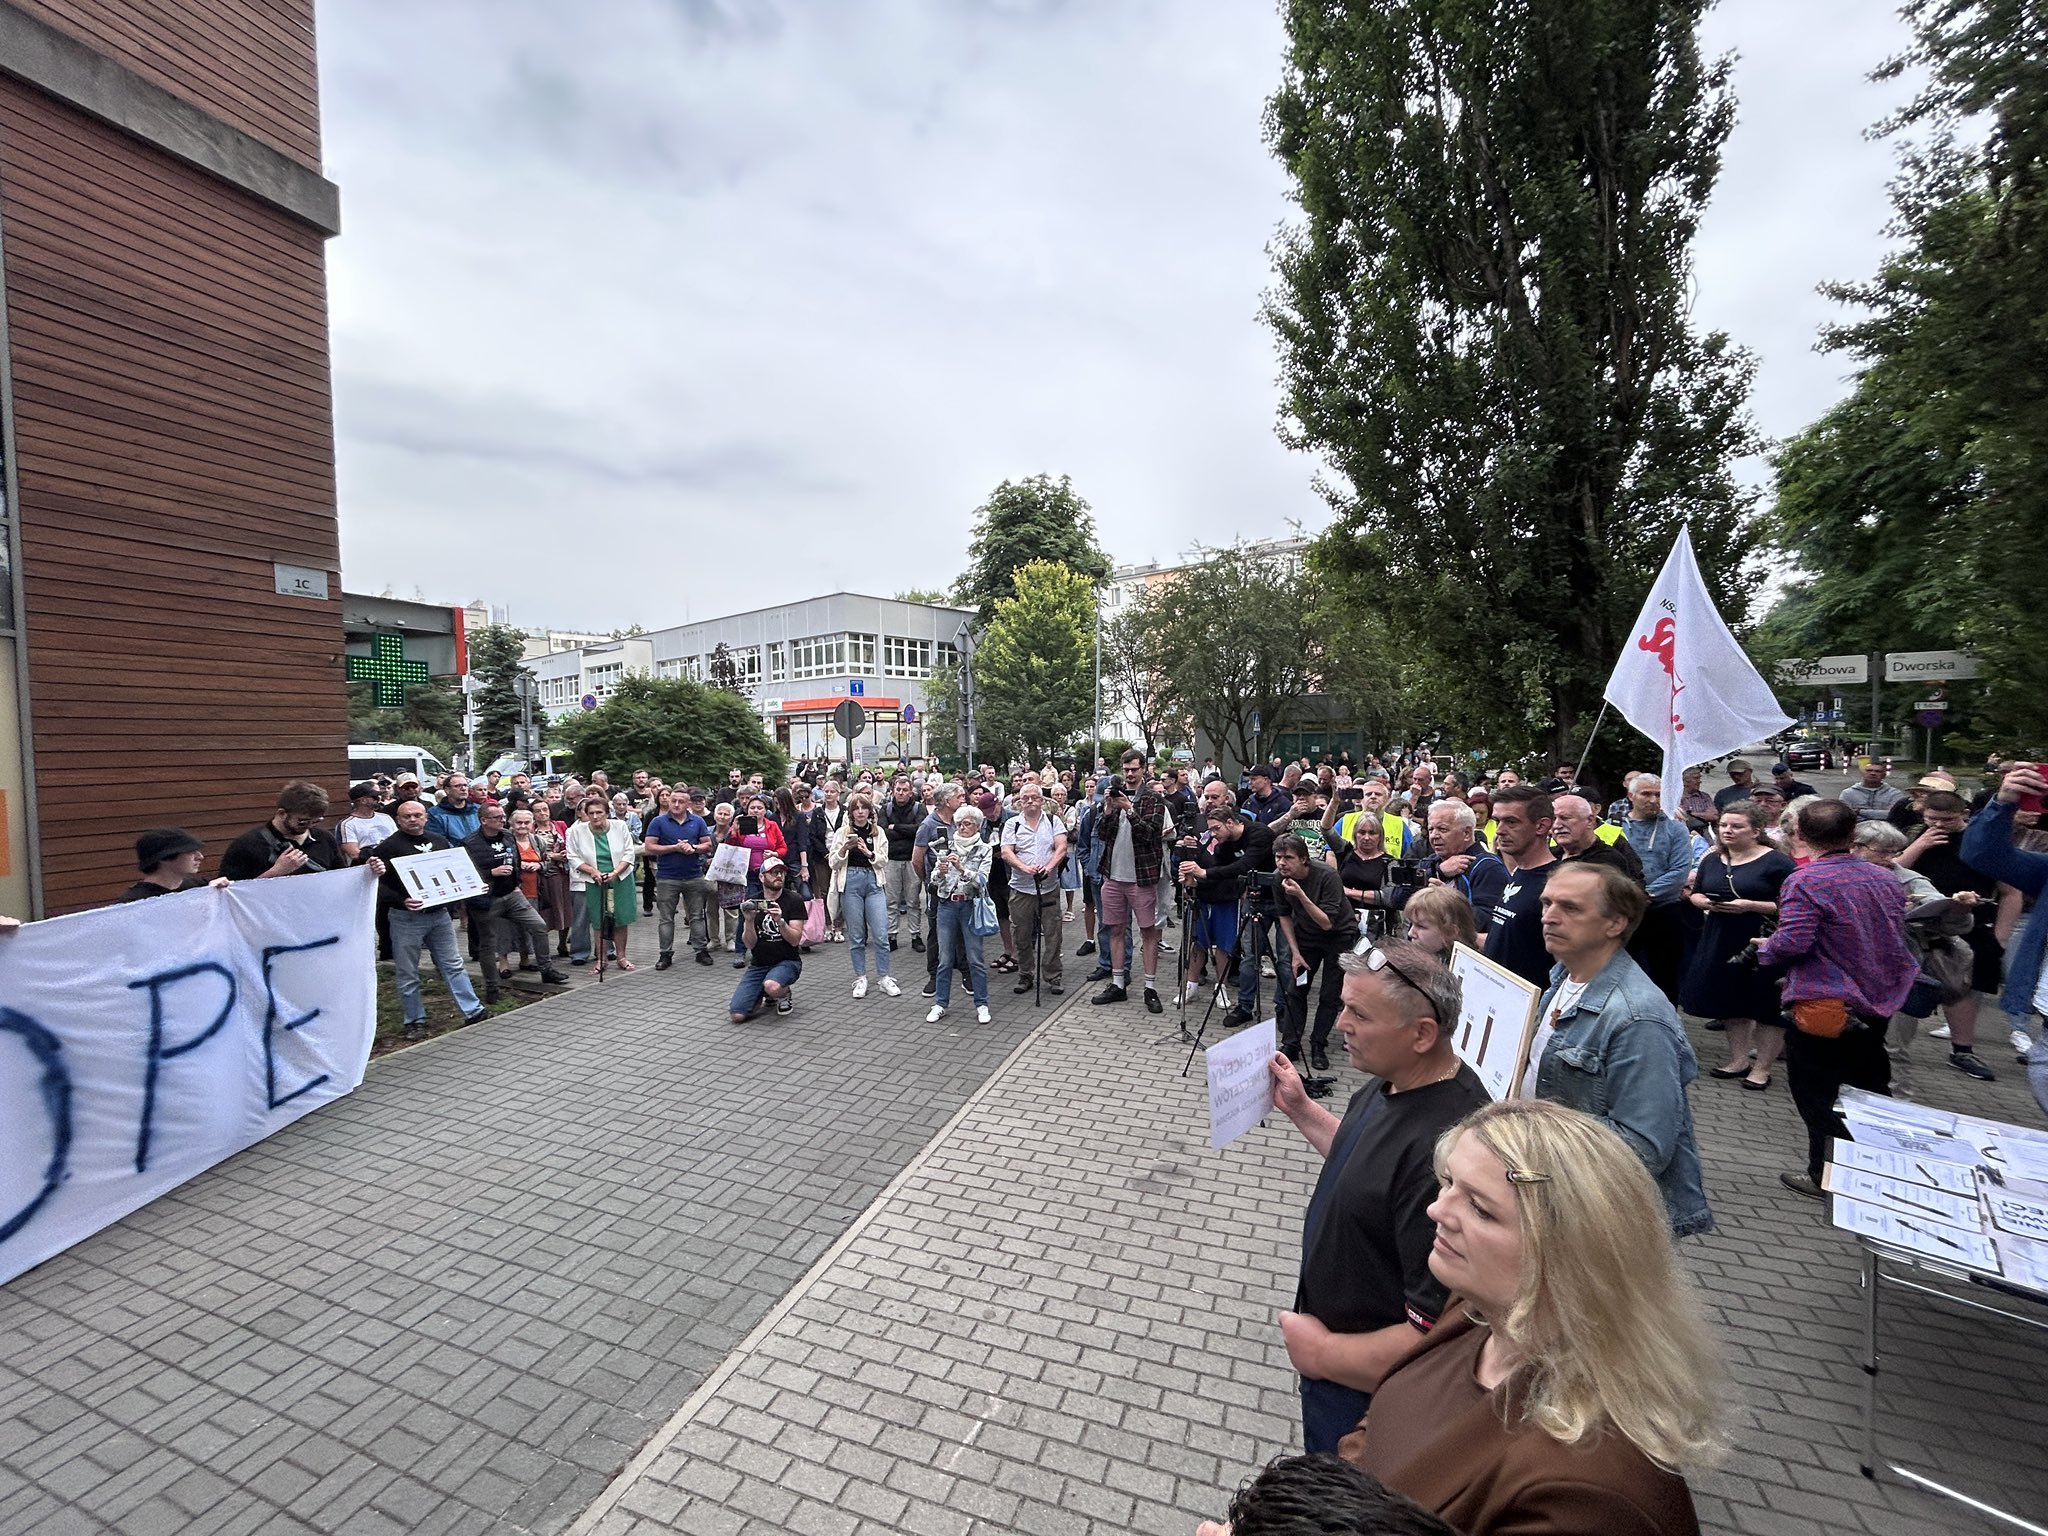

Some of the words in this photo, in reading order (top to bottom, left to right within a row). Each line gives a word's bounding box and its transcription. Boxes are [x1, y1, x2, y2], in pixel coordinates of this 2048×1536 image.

[294, 579, 310, 589] 1C
[1893, 660, 1955, 672] Dworska
[855, 684, 859, 693] 1
